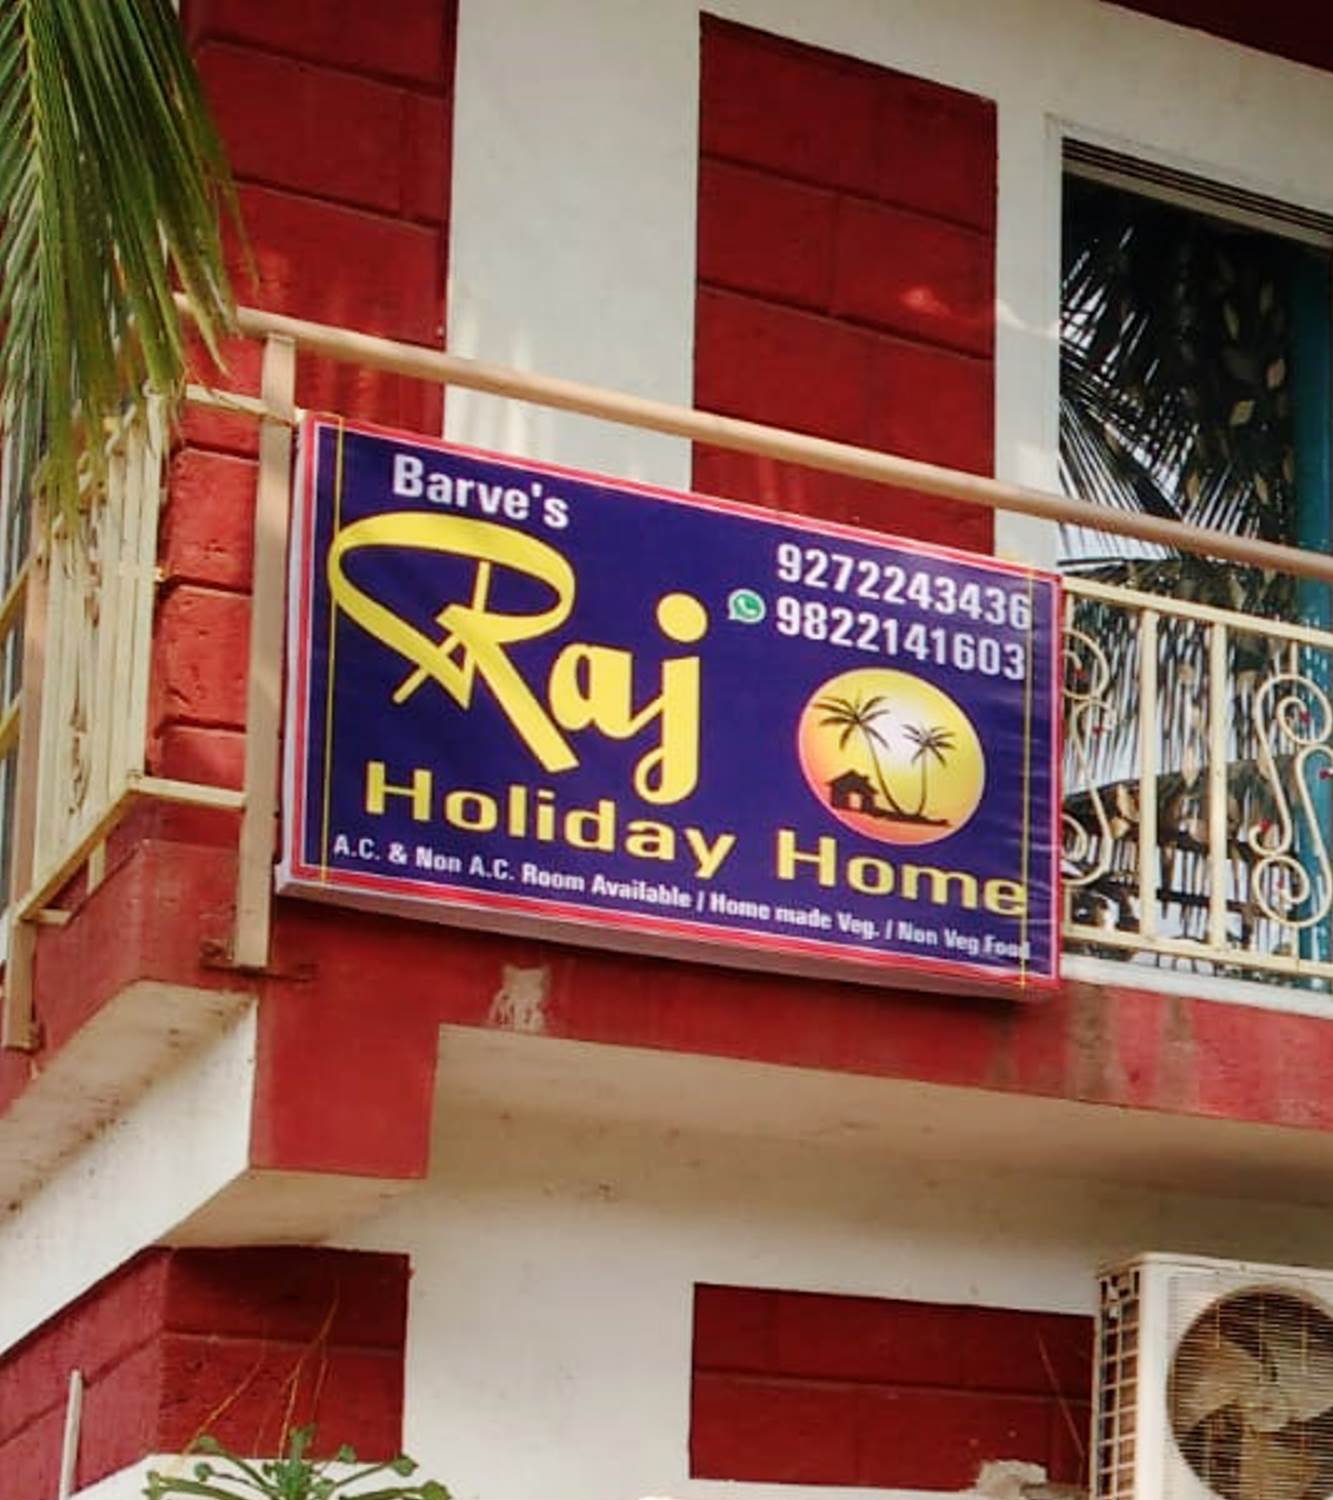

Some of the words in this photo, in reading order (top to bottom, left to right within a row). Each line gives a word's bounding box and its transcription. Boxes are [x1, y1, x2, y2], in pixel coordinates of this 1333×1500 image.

[393, 454, 570, 529] Barve's
[776, 596, 1027, 681] 9822141603
[777, 543, 1033, 631] 9272243436
[326, 510, 708, 807] Raj
[366, 761, 736, 881] Holiday
[776, 829, 1028, 918] Home
[333, 834, 380, 861] A.C.
[388, 843, 408, 865] &
[416, 846, 462, 873] Non
[469, 858, 515, 881] A.C.
[522, 863, 585, 891] Room
[591, 875, 693, 909] Available
[709, 892, 771, 921] Home
[775, 905, 832, 930] made
[837, 913, 880, 941] Veg.
[899, 922, 938, 945] Non
[944, 926, 979, 955] Veg
[984, 938, 1031, 961] Food
